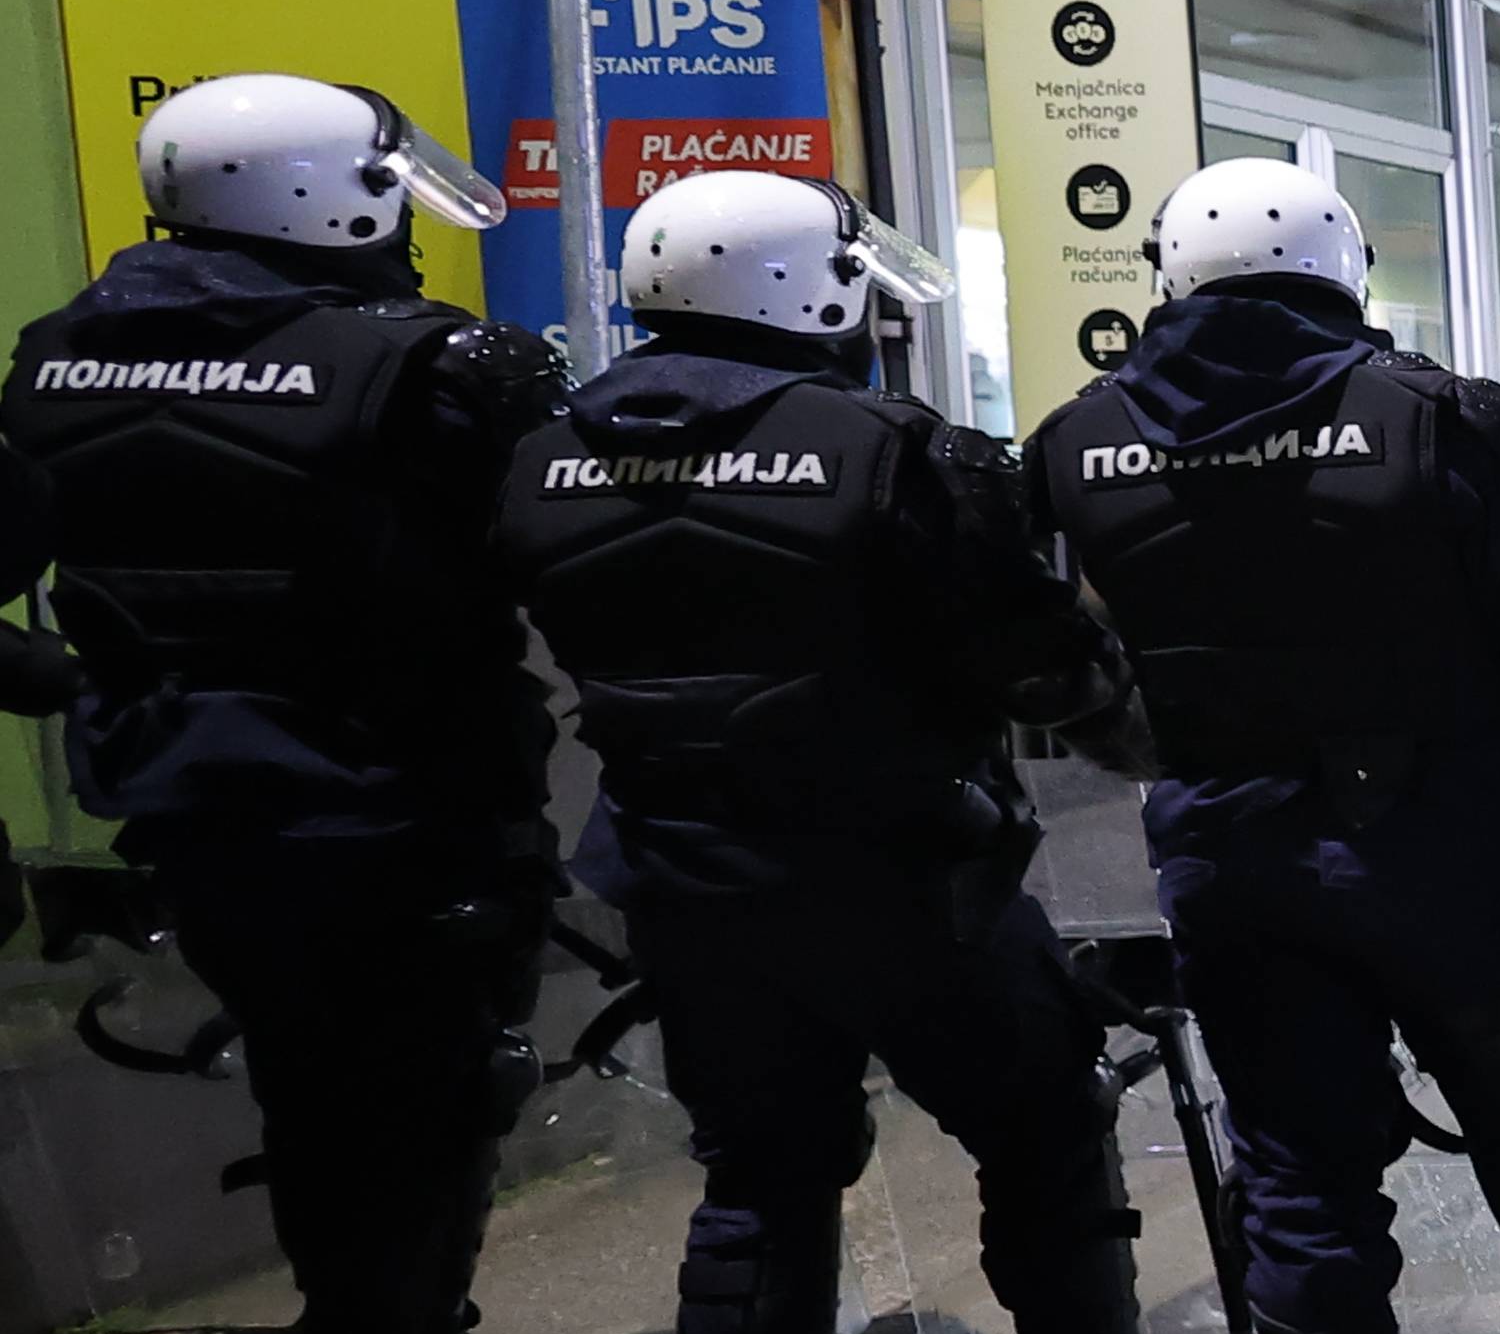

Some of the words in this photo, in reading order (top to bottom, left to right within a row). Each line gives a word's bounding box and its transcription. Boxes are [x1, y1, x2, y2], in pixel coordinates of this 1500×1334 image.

[592, 56, 661, 76] STANT
[1035, 78, 1146, 100] Menjačnica
[1044, 102, 1139, 122] Exchange
[1065, 123, 1121, 140] office
[641, 129, 813, 162] PLAĆANJE
[1062, 244, 1143, 265] Plaćanje
[1070, 266, 1138, 283] računa
[35, 359, 316, 395] ПОЛИЦИЈА
[544, 451, 827, 490] ПОЛИЦИЈА
